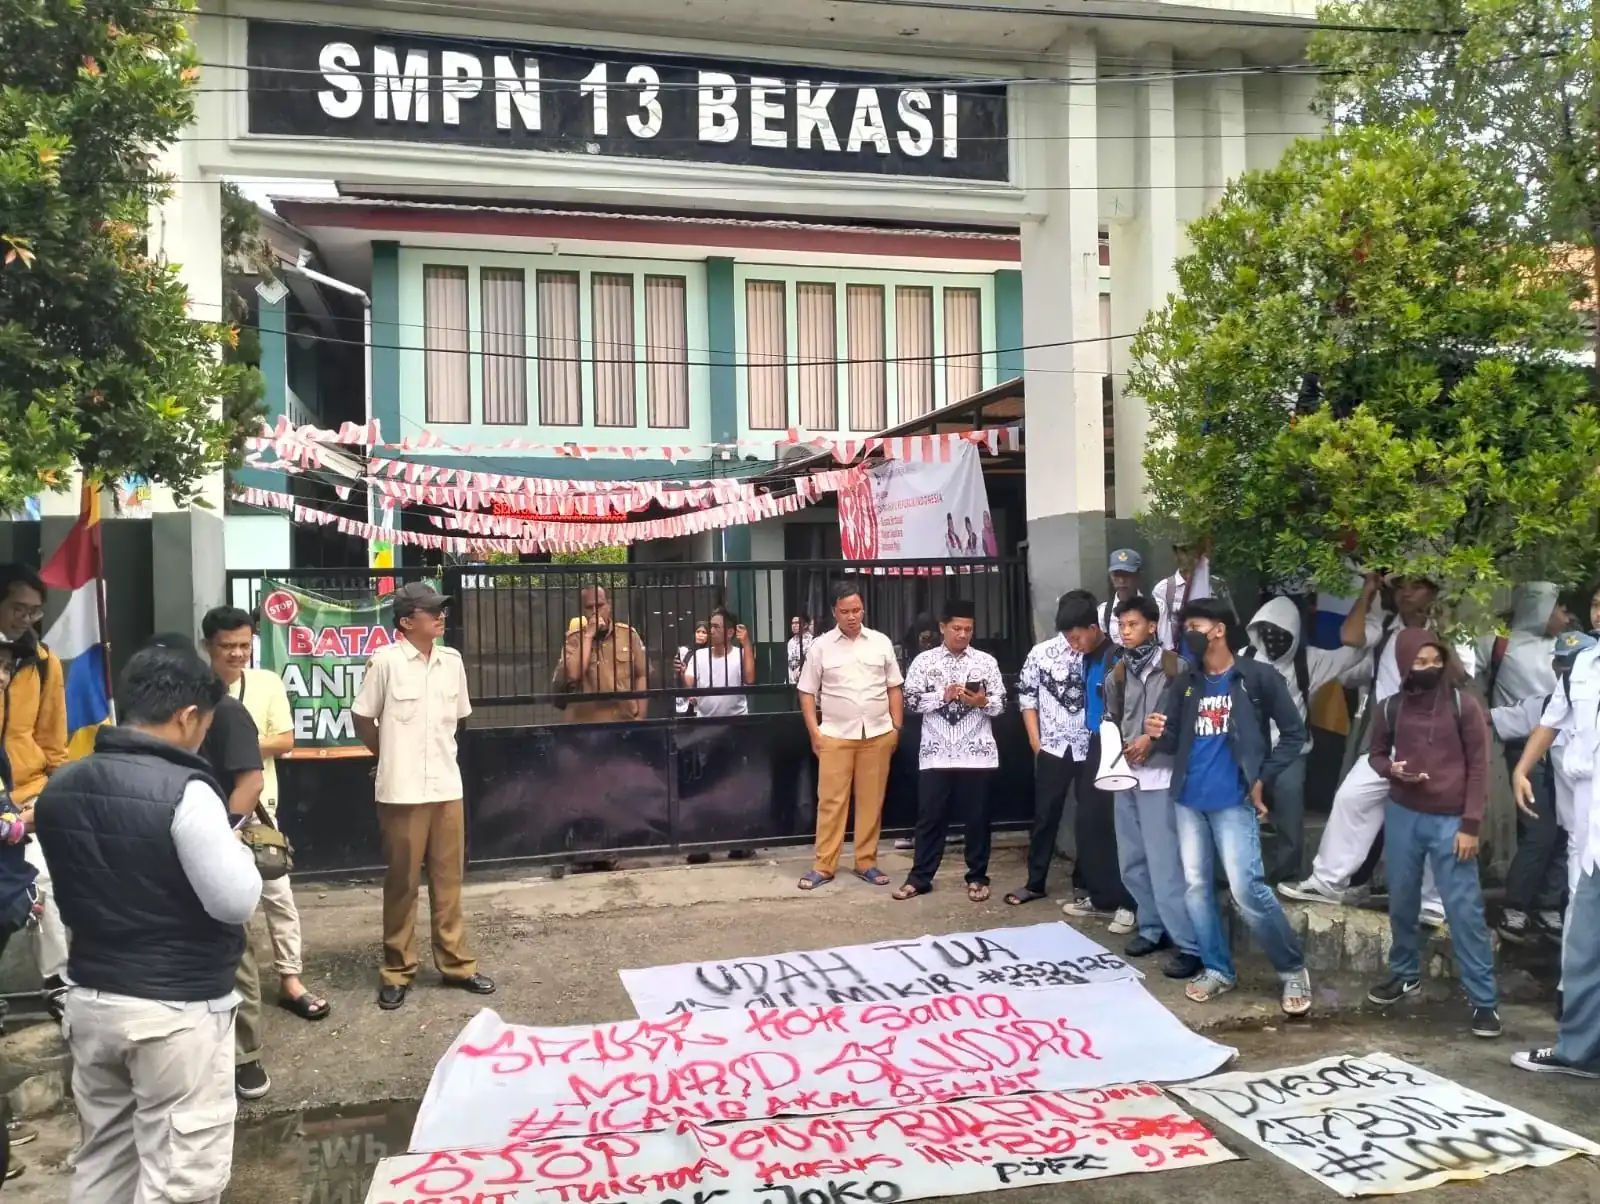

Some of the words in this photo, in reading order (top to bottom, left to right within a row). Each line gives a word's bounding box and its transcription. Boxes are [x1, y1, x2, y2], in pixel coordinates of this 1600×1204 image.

[317, 42, 541, 131] SMPN
[579, 62, 662, 140] 13
[697, 70, 959, 159] BEKASI
[269, 600, 293, 616] STOP
[289, 626, 402, 656] BATA
[696, 952, 867, 996] UDAH
[873, 936, 1020, 972] TUA
